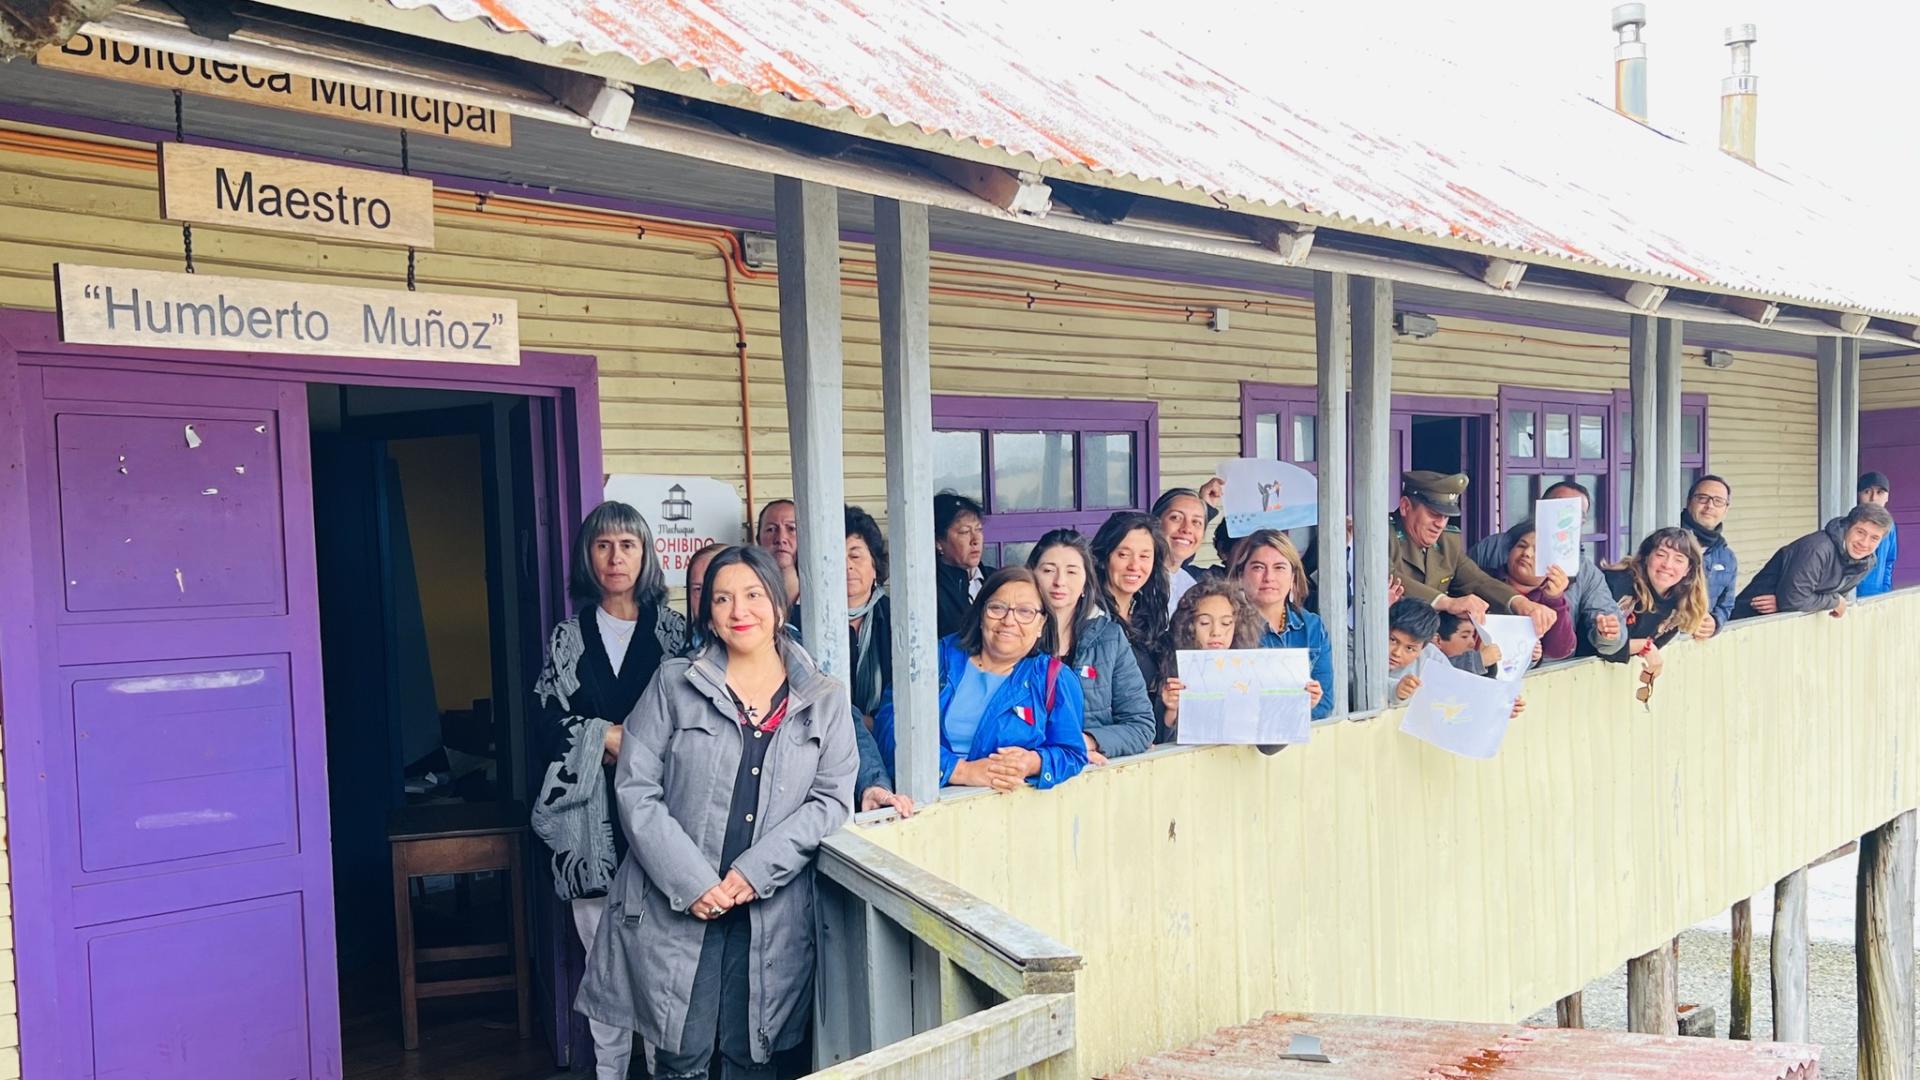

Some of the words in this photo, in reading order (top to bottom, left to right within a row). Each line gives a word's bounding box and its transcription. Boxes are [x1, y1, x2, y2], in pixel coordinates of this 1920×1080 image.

[216, 167, 391, 229] Maestro
[84, 284, 329, 341] “Humberto
[363, 304, 503, 350] Muñoz”
